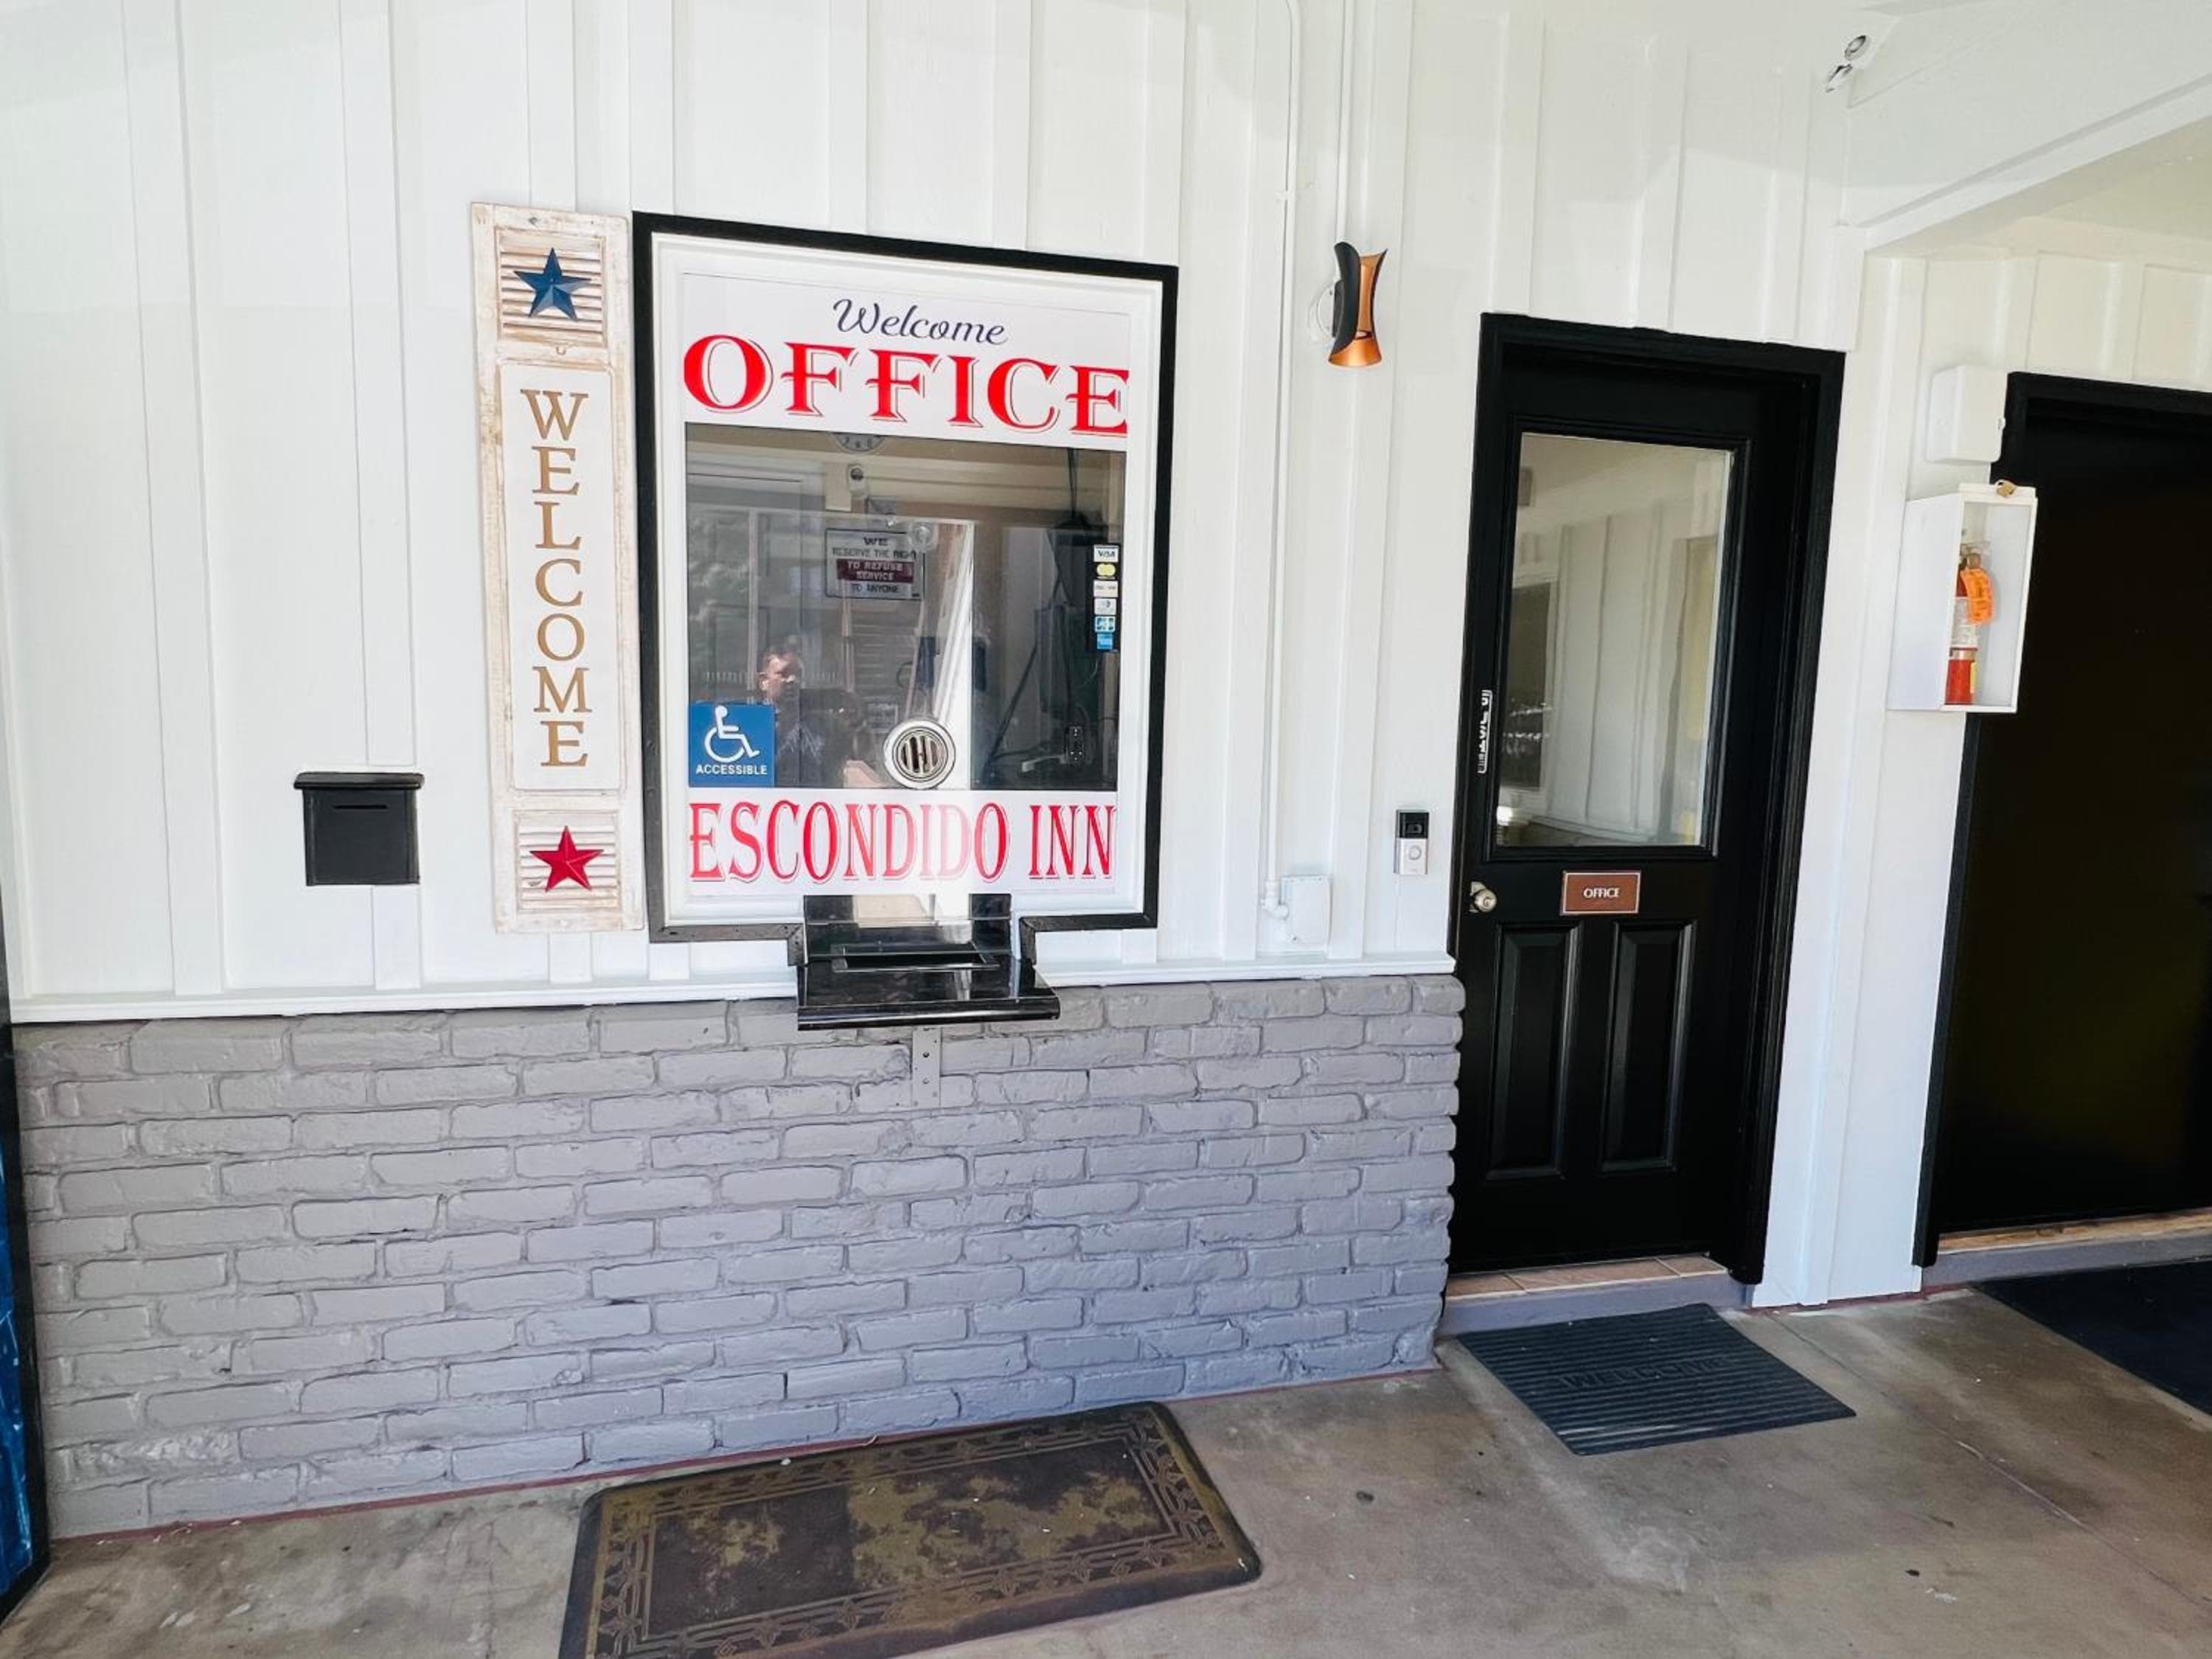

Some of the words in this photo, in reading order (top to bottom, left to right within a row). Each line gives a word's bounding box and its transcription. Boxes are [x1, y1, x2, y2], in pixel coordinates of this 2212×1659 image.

[833, 298, 1008, 345] Welcome
[684, 334, 1130, 438] OFFICE
[863, 537, 888, 546] WE
[874, 549, 890, 558] THE
[849, 561, 860, 569] TO
[864, 562, 903, 571] REFUSE
[520, 388, 592, 768] WELCOME
[856, 571, 894, 581] SERVICE
[852, 583, 863, 591] TO
[866, 583, 900, 594] ANYONE
[695, 764, 768, 776] ACCESSIBLE
[689, 799, 1011, 884] ESCONDIDO
[1028, 804, 1117, 880] INN
[1583, 887, 1621, 899] OFFICE
